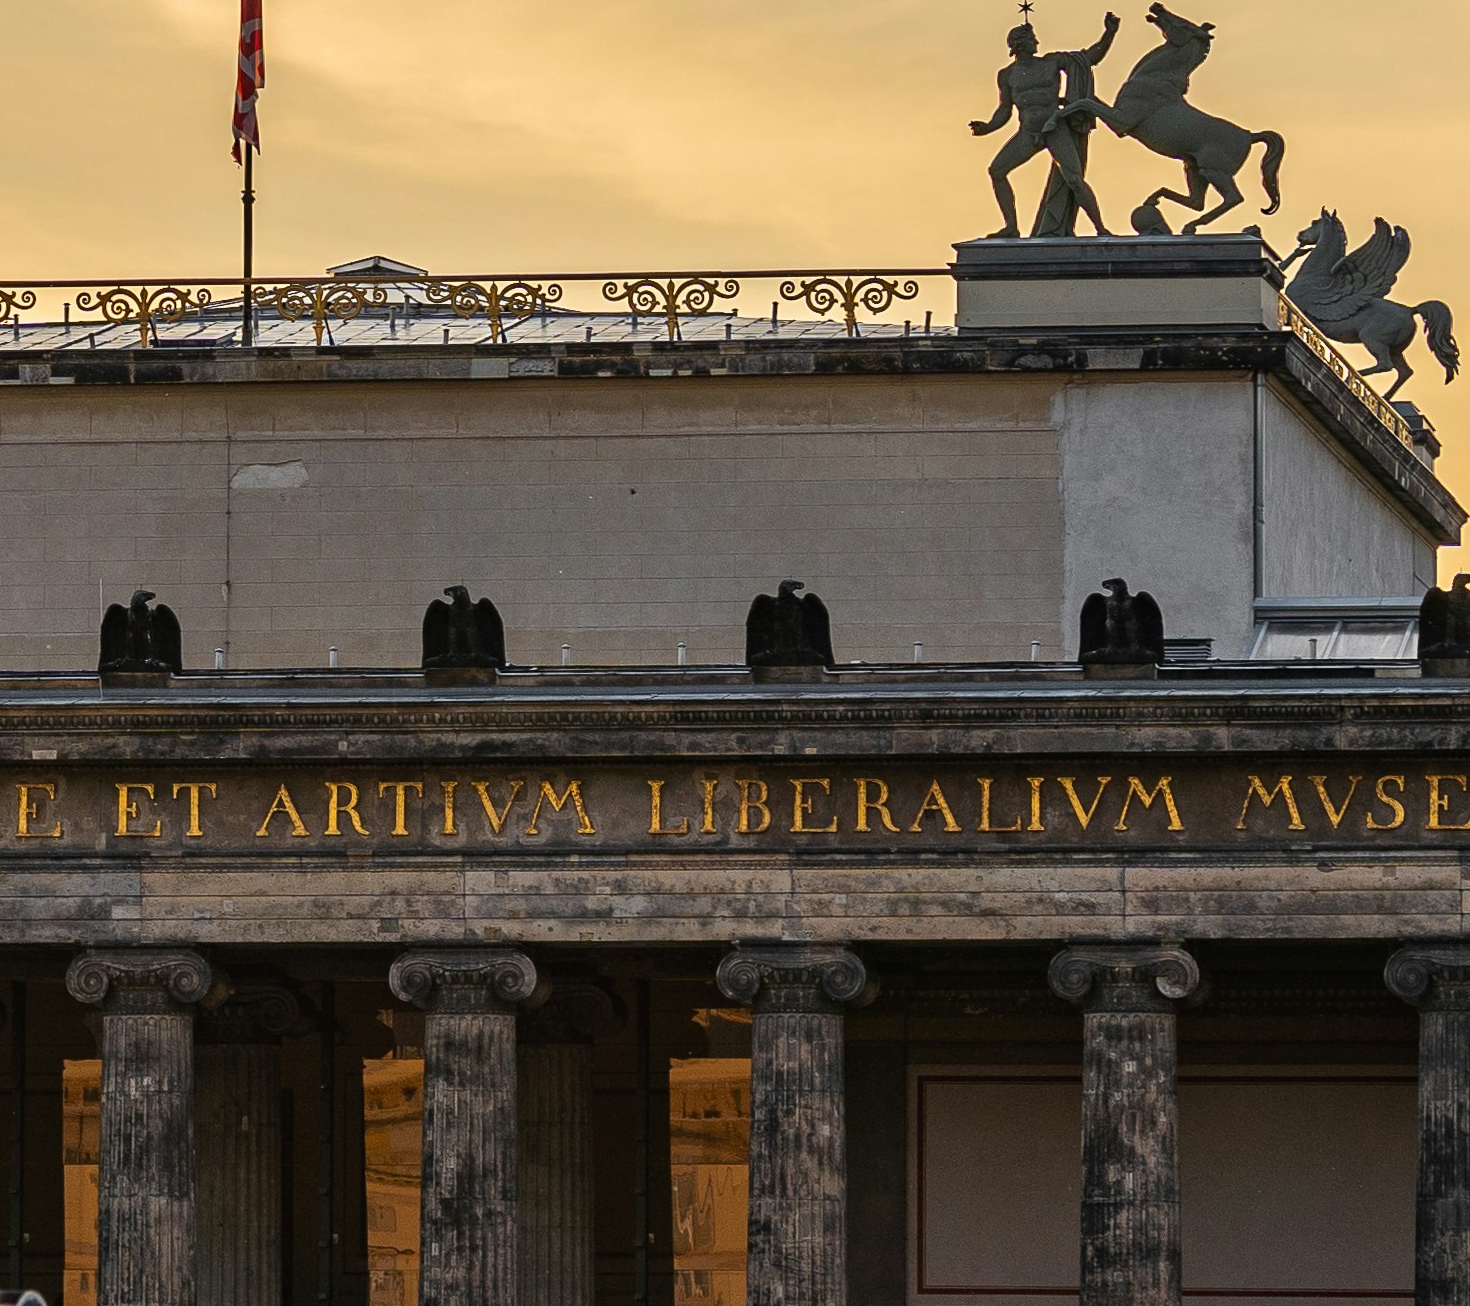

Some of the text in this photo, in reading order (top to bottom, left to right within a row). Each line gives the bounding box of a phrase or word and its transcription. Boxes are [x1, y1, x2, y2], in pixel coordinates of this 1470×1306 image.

[114, 781, 217, 838] ET
[255, 779, 596, 838] ARTIVM
[647, 776, 1185, 835] LIBERALIVM
